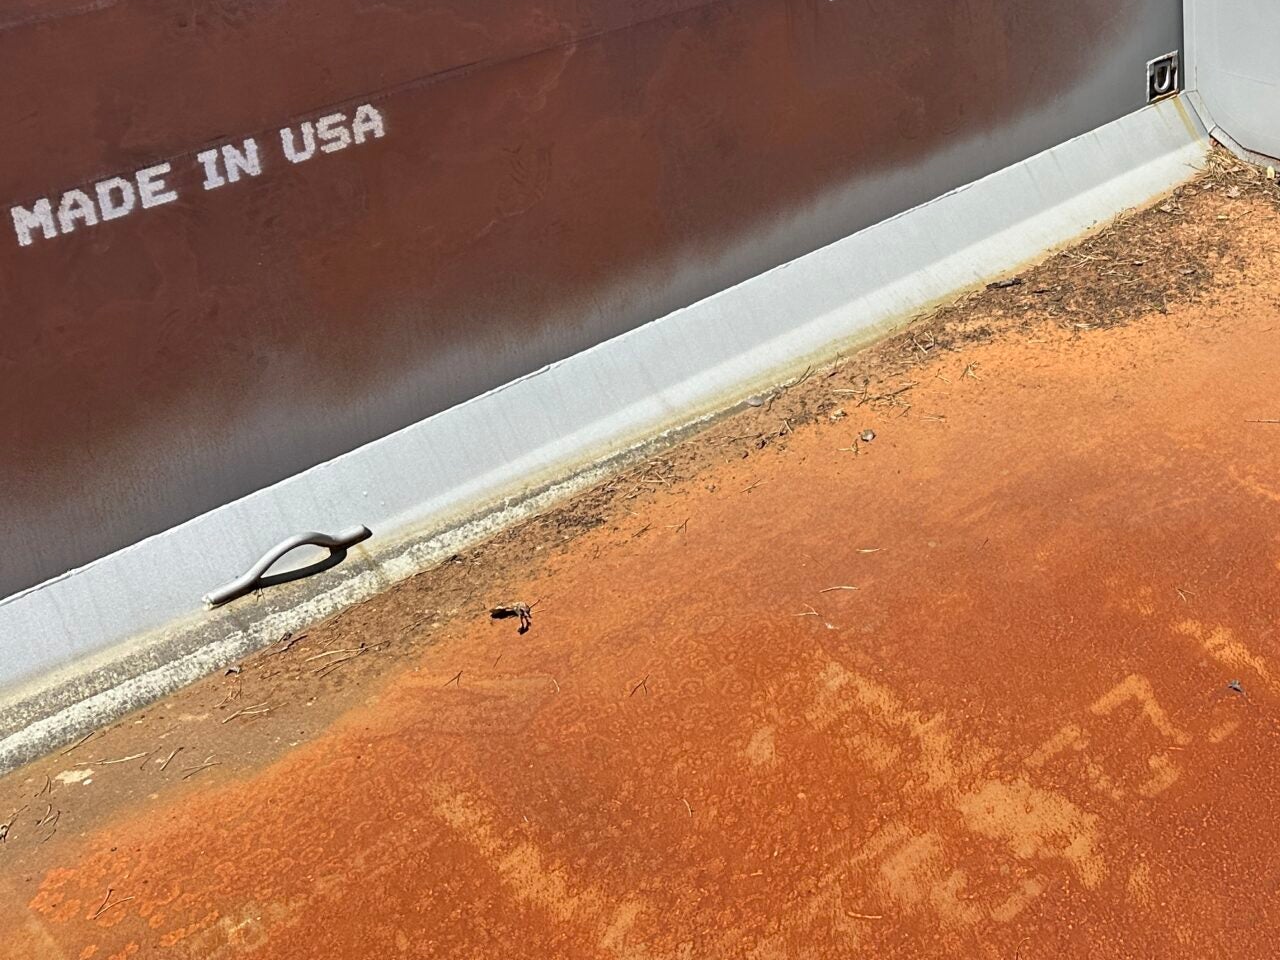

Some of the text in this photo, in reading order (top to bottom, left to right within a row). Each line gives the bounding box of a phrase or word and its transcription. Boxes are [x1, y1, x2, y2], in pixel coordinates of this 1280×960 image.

[10, 103, 385, 246] MADE IN USA
